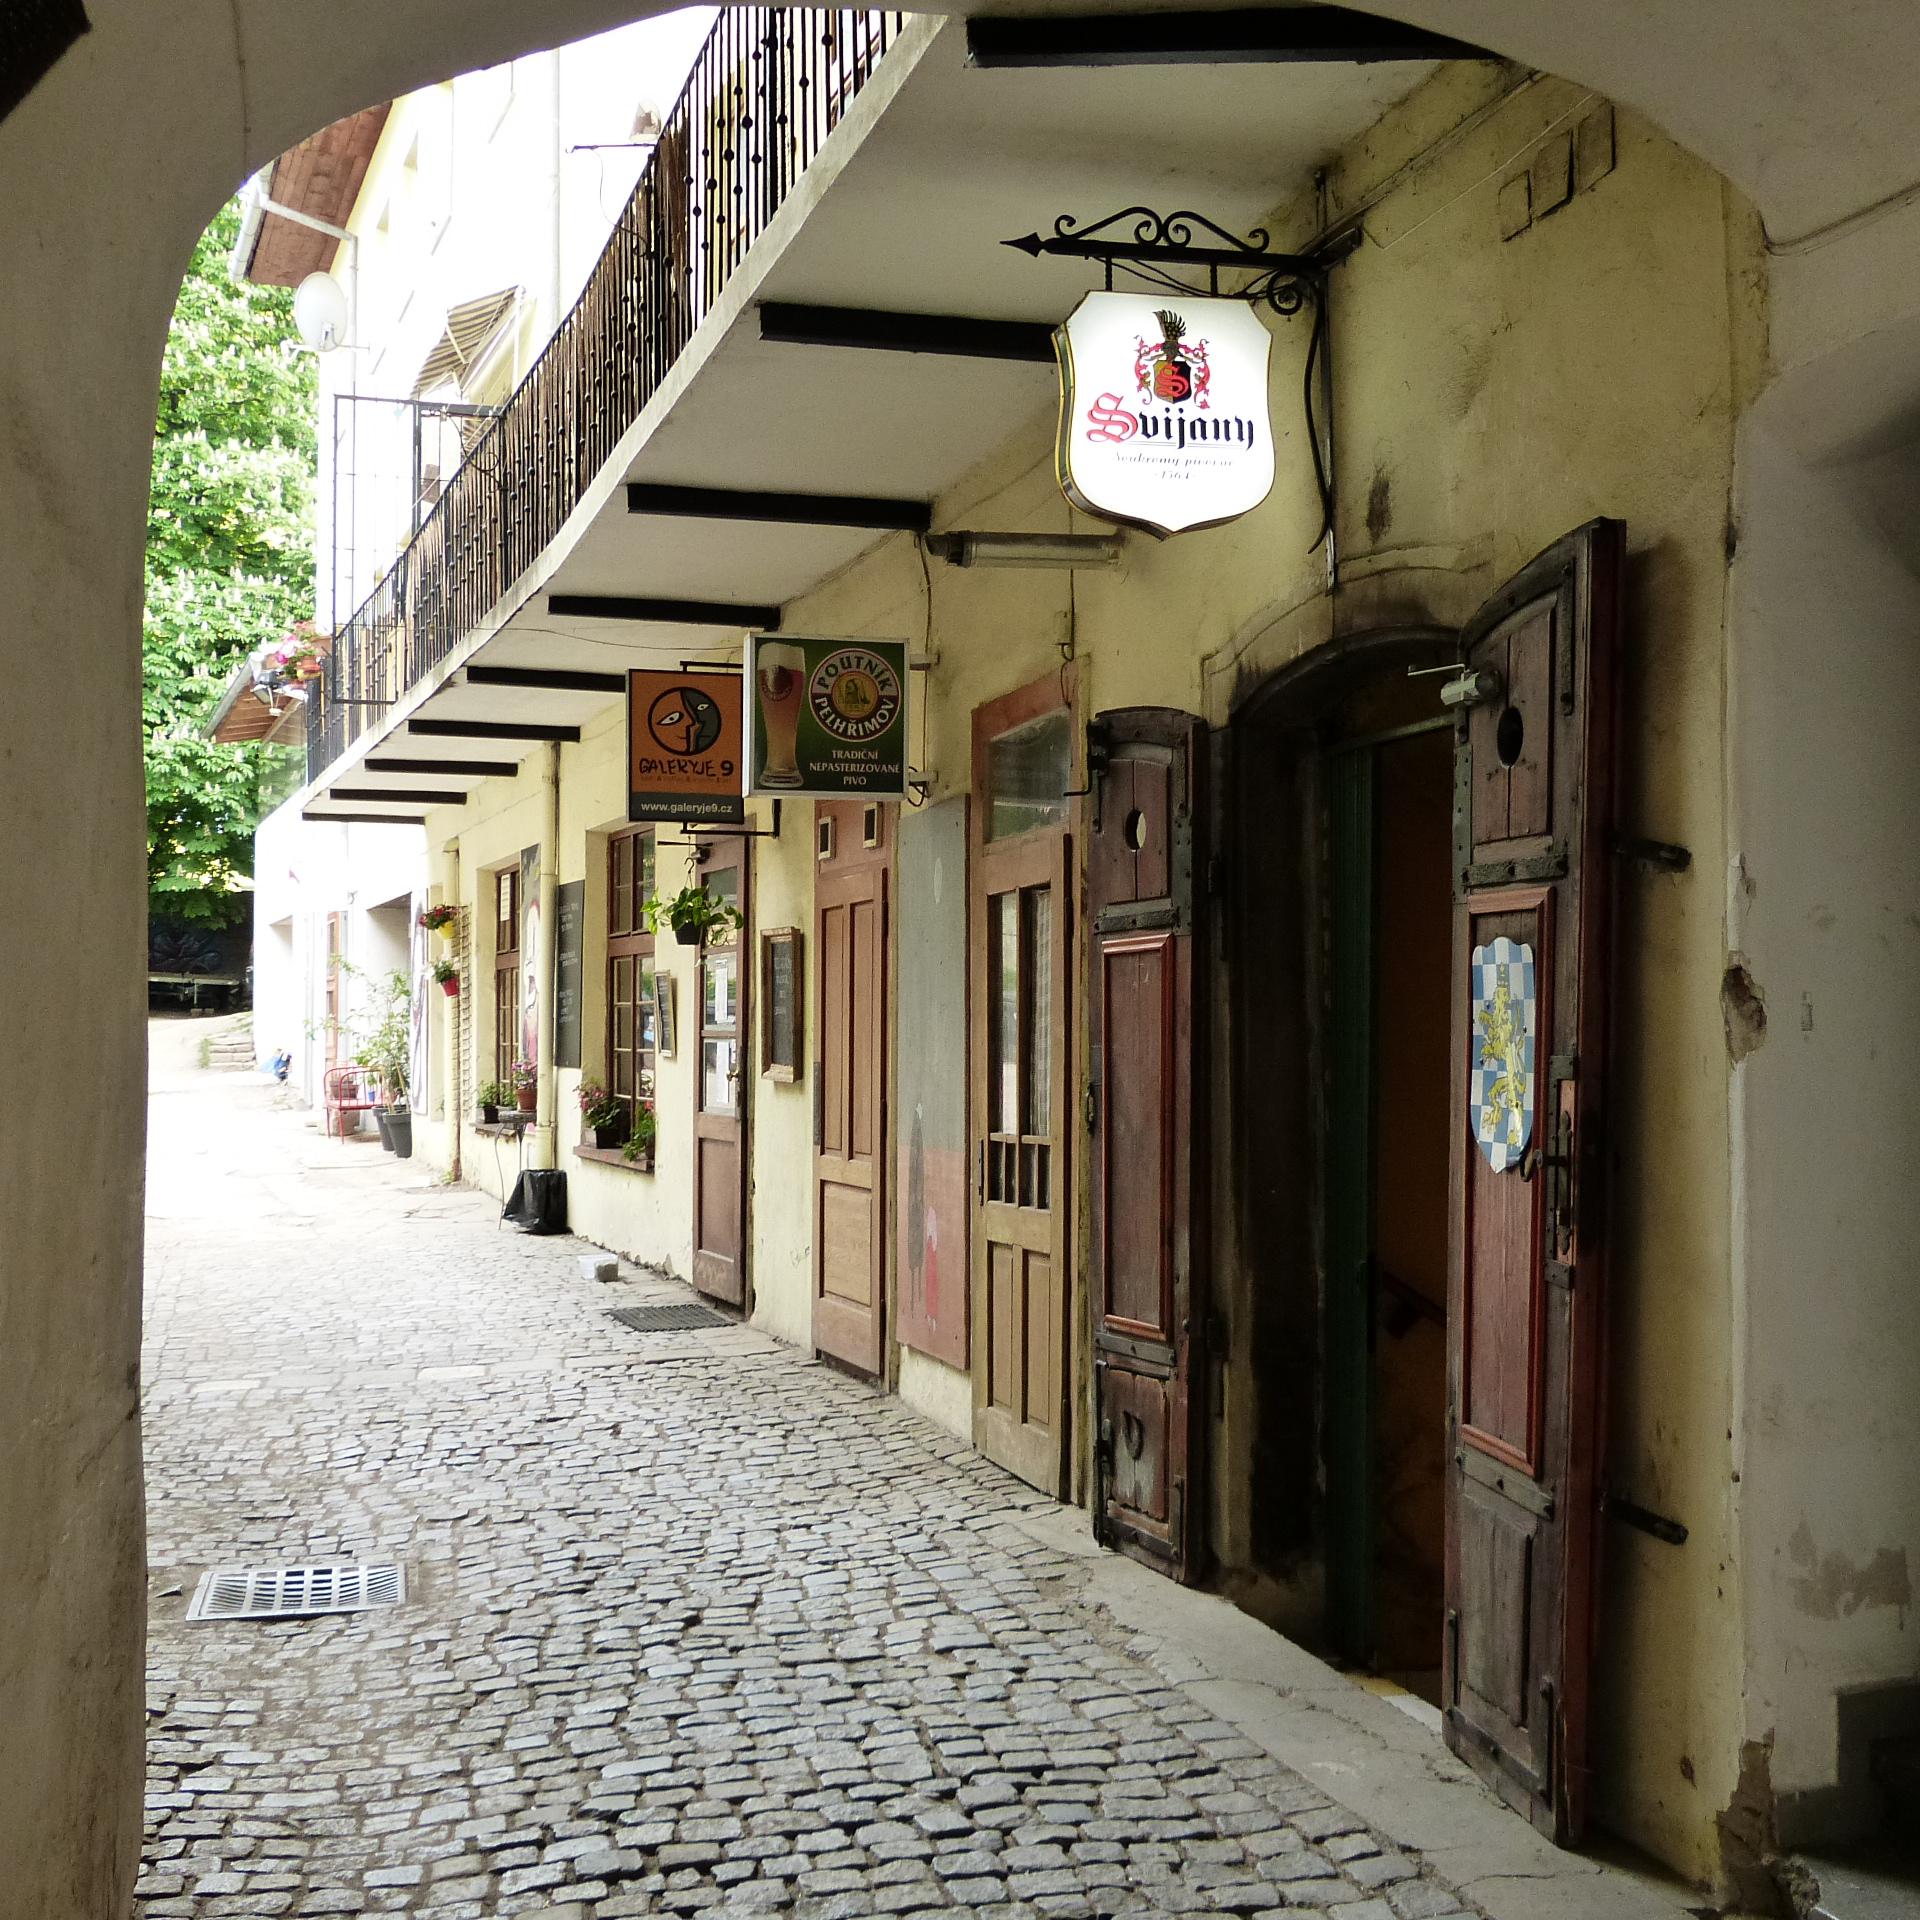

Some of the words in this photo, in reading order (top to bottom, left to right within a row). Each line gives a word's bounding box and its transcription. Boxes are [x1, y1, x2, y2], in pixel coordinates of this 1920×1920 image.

[1086, 392, 1254, 450] Svijany
[816, 656, 893, 691] POUTNÍK
[815, 697, 895, 736] PELHŘIMOV
[843, 776, 867, 785] PIVO
[640, 802, 734, 815] www.galeryje9.cz
